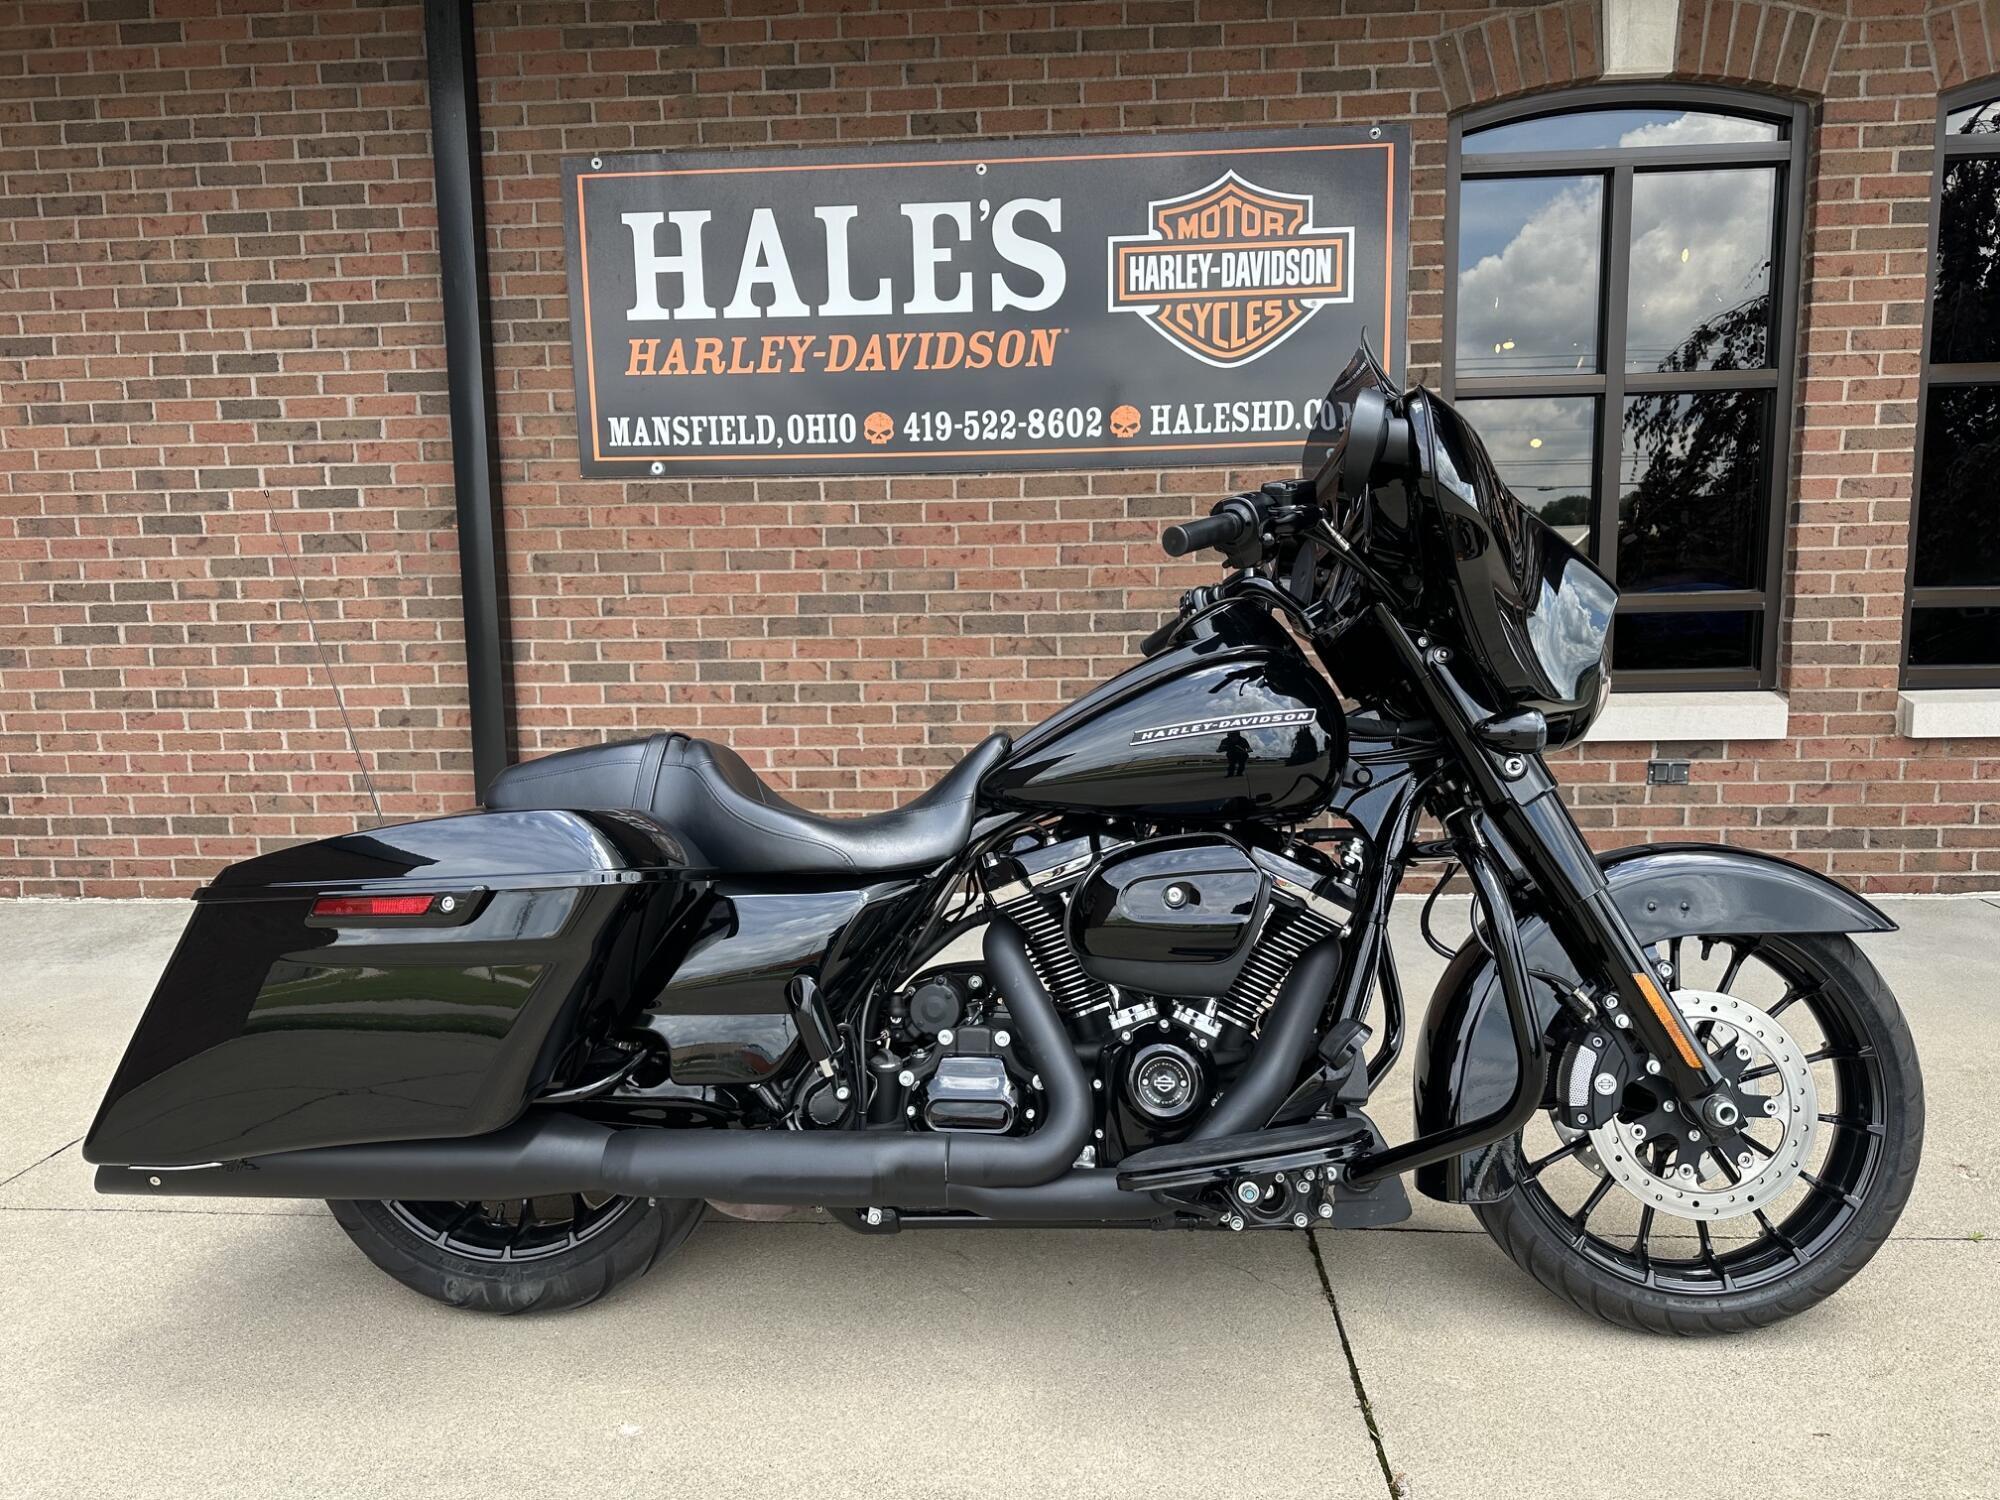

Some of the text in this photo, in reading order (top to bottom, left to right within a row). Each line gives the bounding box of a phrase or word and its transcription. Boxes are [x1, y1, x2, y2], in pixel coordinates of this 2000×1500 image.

[1177, 199, 1284, 239] MOTOR
[620, 197, 1067, 321] HALE'S
[1129, 247, 1332, 292] HARLEY-DAVIDSON
[1176, 299, 1283, 349] CYCLES
[624, 328, 1060, 376] HARLEY-DAVIDSON
[608, 413, 857, 448] MANSFIELD, OHIO
[903, 406, 1103, 441] 419-522-8602
[1141, 712, 1309, 740] HARLEY-DAVIDSON
